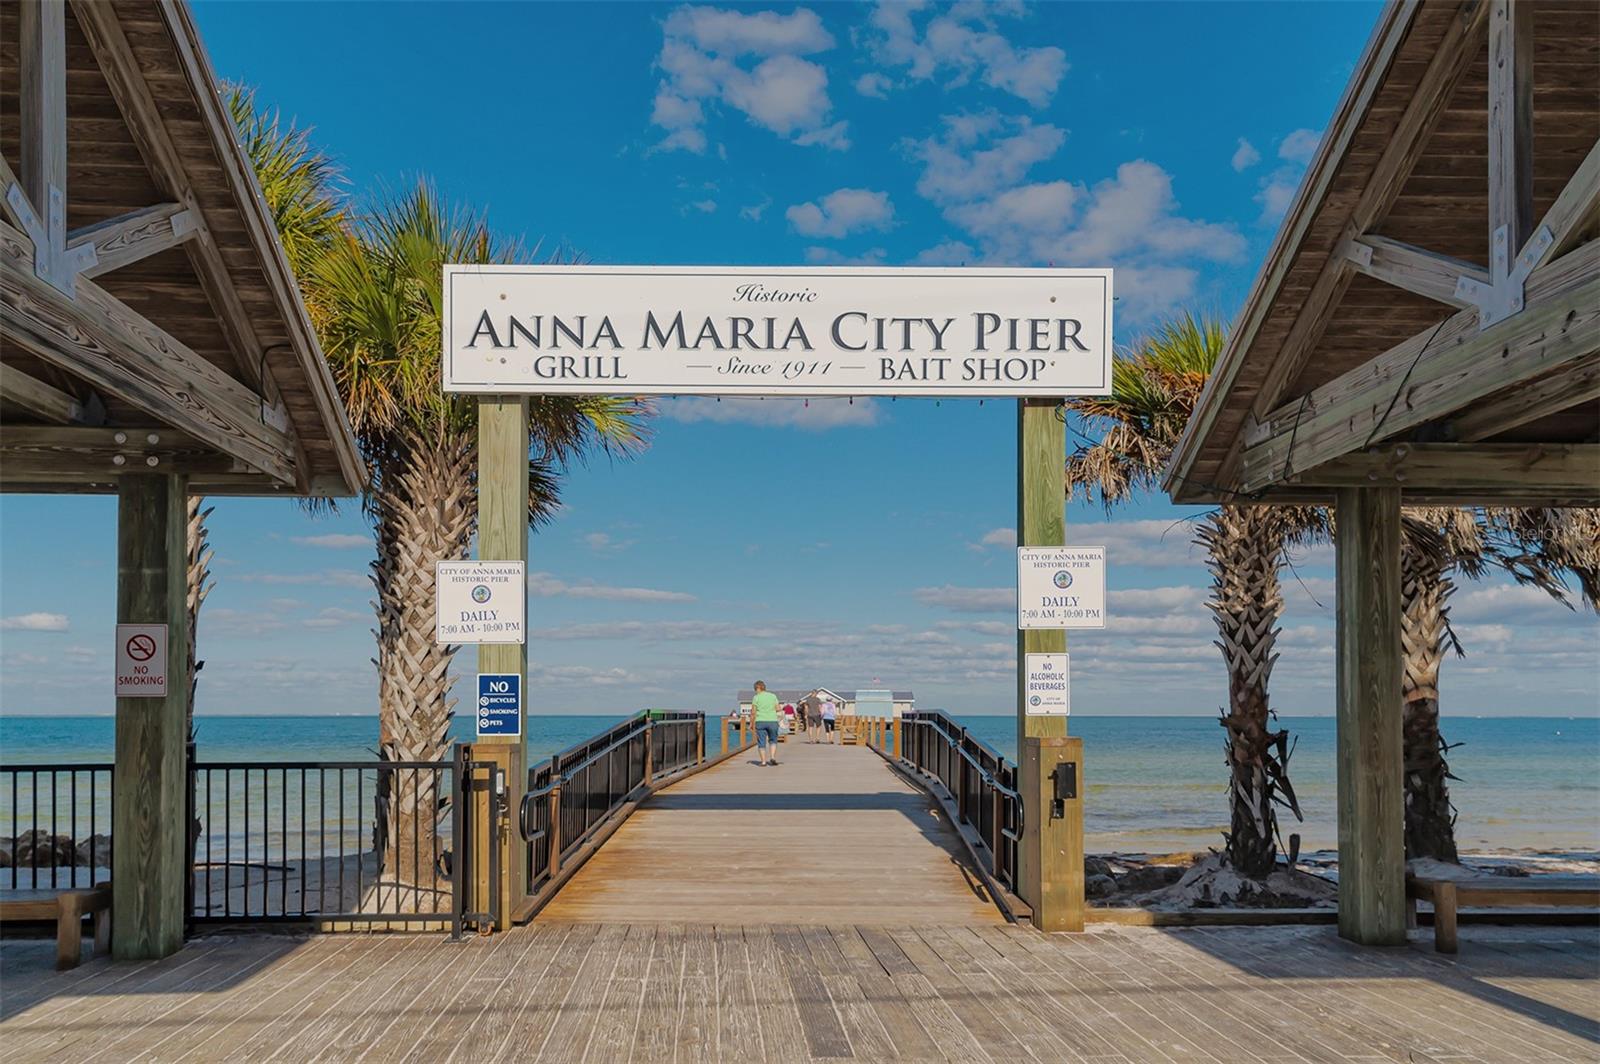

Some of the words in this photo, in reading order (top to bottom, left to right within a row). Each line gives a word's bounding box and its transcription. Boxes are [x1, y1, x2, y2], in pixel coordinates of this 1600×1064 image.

[732, 283, 818, 303] Historic
[462, 308, 625, 350] ANNA
[639, 309, 815, 351] MARIA
[829, 311, 956, 352] CITY
[971, 311, 1090, 353] PIER
[533, 355, 628, 379] GRILL
[716, 355, 772, 375] Since
[781, 359, 832, 380] 1911
[879, 357, 951, 381] BAIT
[962, 357, 1046, 381] SHOP
[1033, 561, 1071, 569] HISTORIC
[440, 568, 458, 576] CITY
[1042, 596, 1080, 607] DAILY
[461, 610, 499, 622] DAILY
[1022, 609, 1039, 619] 7:00
[1040, 609, 1055, 618] AM
[1063, 609, 1084, 618] 10:00
[1085, 609, 1100, 618] PM
[441, 625, 458, 635] 7:00
[460, 624, 475, 634] AM
[483, 623, 503, 633] 10:00
[505, 622, 520, 631] PM
[134, 665, 149, 675] NO
[1042, 663, 1053, 671] NO
[118, 675, 164, 686] SMOKING
[1030, 672, 1065, 681] ALCOHOLIC
[489, 681, 509, 693] NO
[1030, 682, 1066, 691] BEVERAGES
